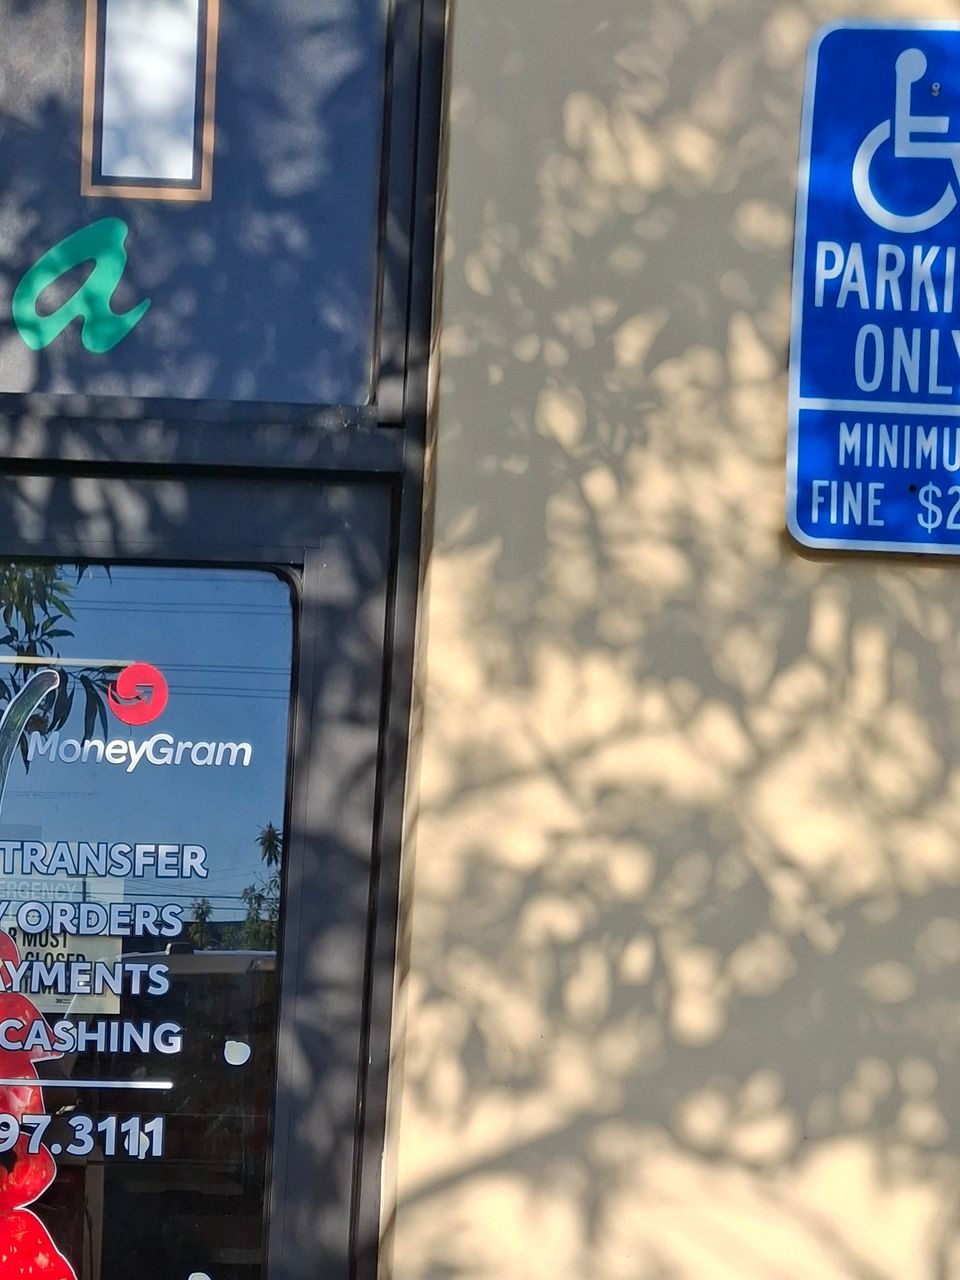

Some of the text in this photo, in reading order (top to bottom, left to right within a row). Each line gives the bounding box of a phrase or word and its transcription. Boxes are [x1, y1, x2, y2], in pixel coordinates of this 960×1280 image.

[811, 479, 885, 526] FINE
[26, 731, 253, 773] MoneyGram
[16, 901, 184, 938] ORDERS
